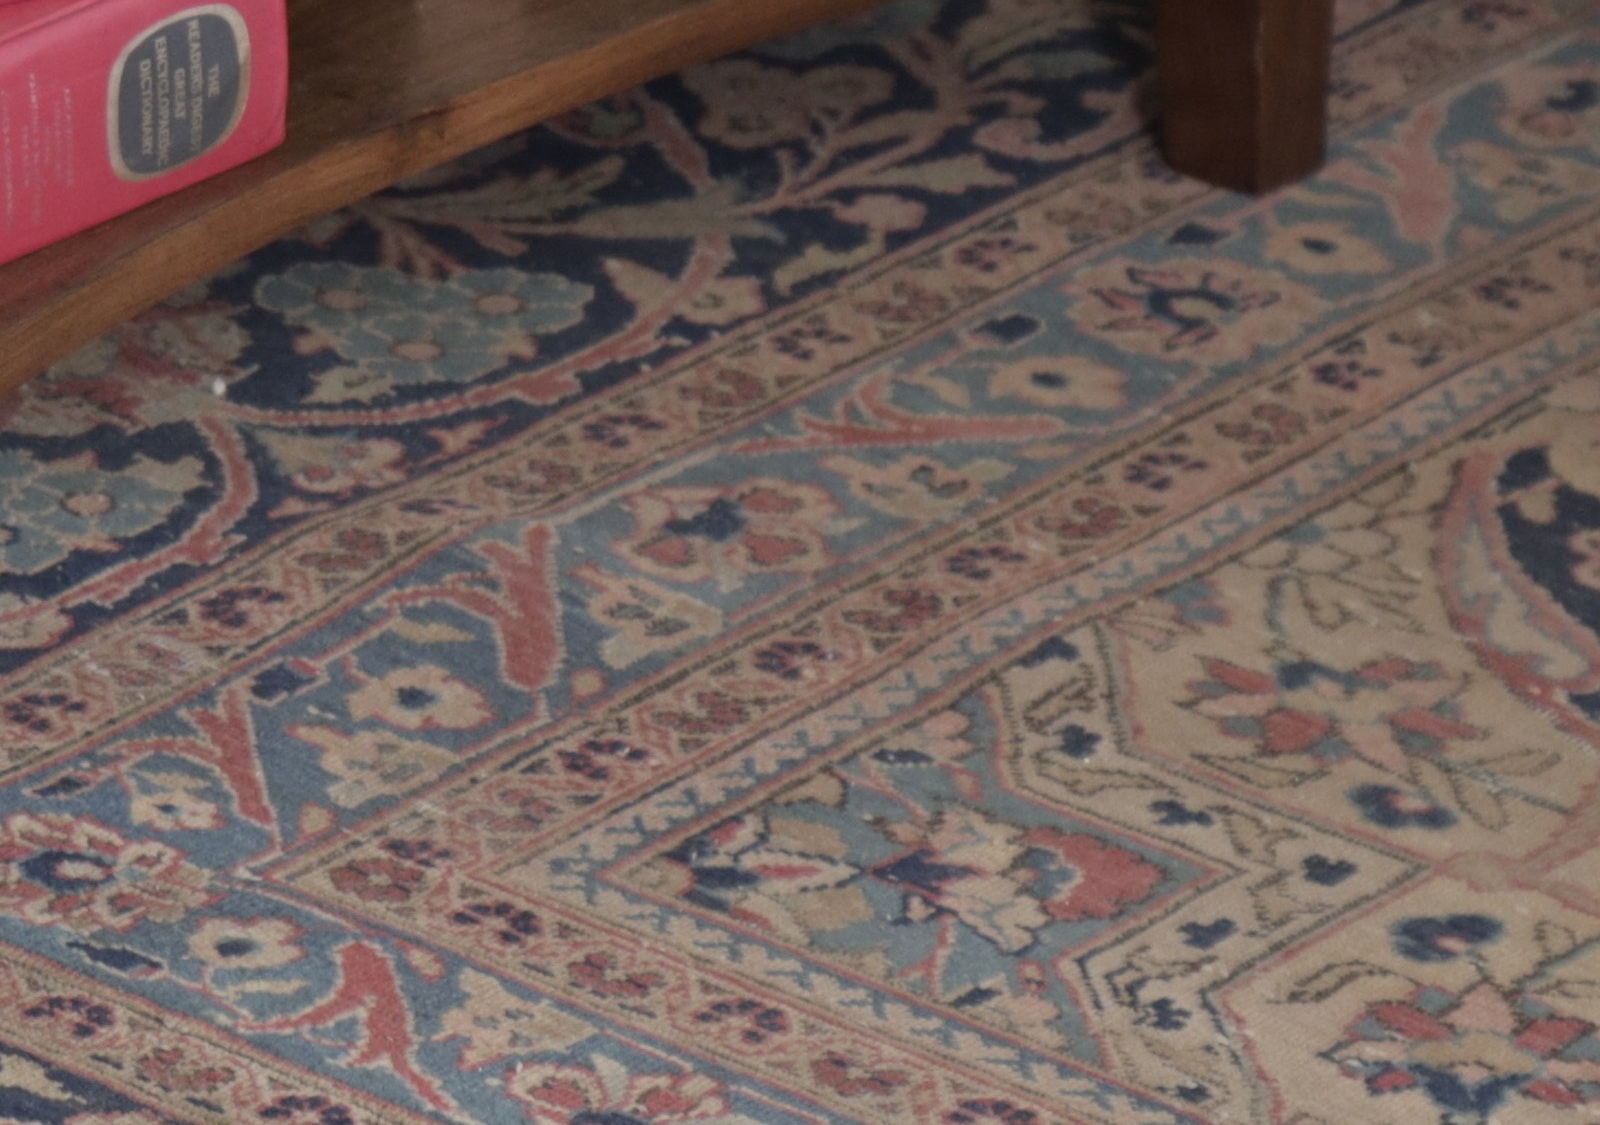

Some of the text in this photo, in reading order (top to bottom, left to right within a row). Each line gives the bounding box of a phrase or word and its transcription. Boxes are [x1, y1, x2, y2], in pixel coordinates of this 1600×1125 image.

[139, 58, 154, 156] DICTIONARY
[173, 67, 187, 120] GREAT
[207, 63, 221, 98] THE
